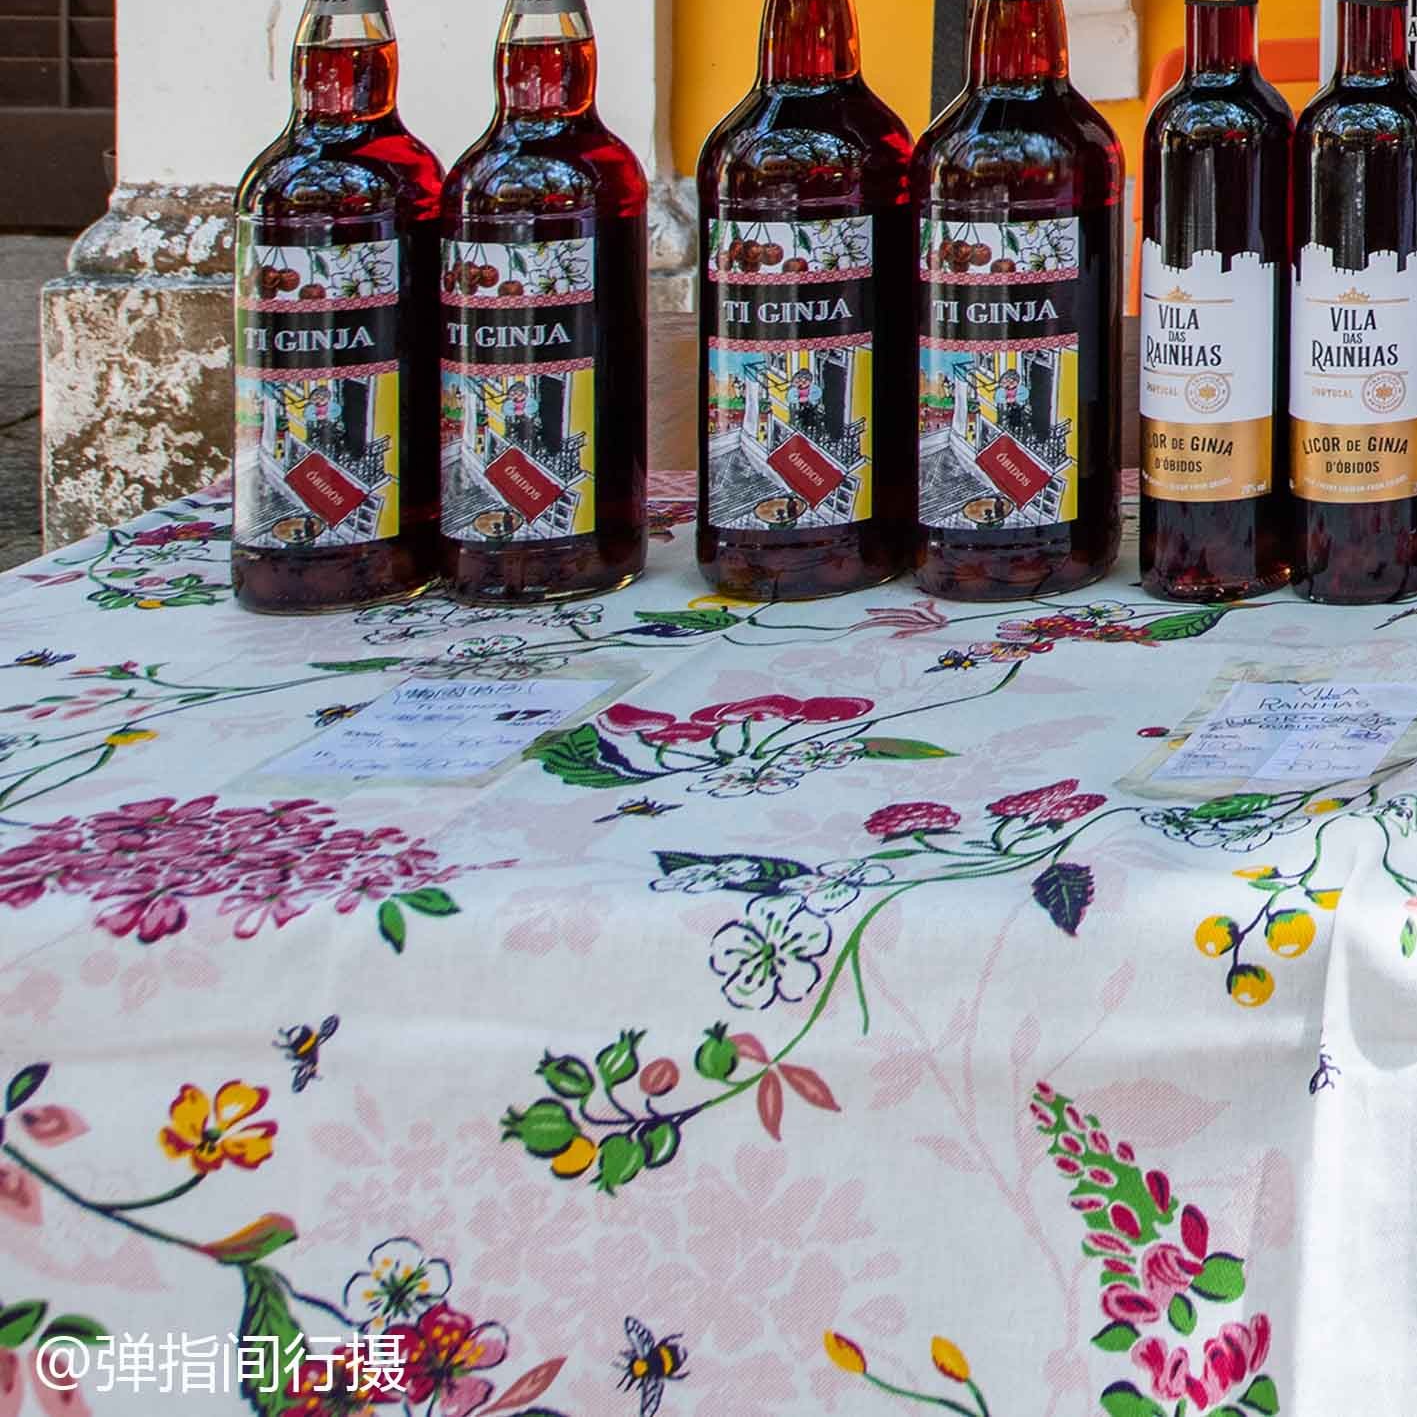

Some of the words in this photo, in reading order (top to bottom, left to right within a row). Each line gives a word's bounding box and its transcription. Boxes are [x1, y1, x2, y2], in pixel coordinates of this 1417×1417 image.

[723, 300, 749, 324] TI
[756, 298, 853, 325] GINJA
[933, 300, 960, 323] TI
[966, 299, 1059, 324] GINJA
[1158, 304, 1200, 330] VILA
[1330, 307, 1377, 332] VILA
[243, 326, 267, 351] TI
[273, 326, 375, 353] GINJA
[447, 322, 470, 346] TI
[474, 322, 572, 349] GINJA
[1168, 331, 1186, 343] DAS
[1343, 332, 1363, 345] DAS
[1146, 335, 1222, 367] RAINHAS
[1311, 340, 1399, 372] RAINHAS
[1171, 438, 1185, 450] DE
[1190, 436, 1233, 456] GINJA
[1302, 436, 1341, 455] LICOR
[1346, 440, 1361, 452] DE
[1367, 435, 1409, 455] GINJA
[1155, 457, 1203, 473] D'ÓBIDOS
[1325, 460, 1380, 475] D'ÓBIDOS
